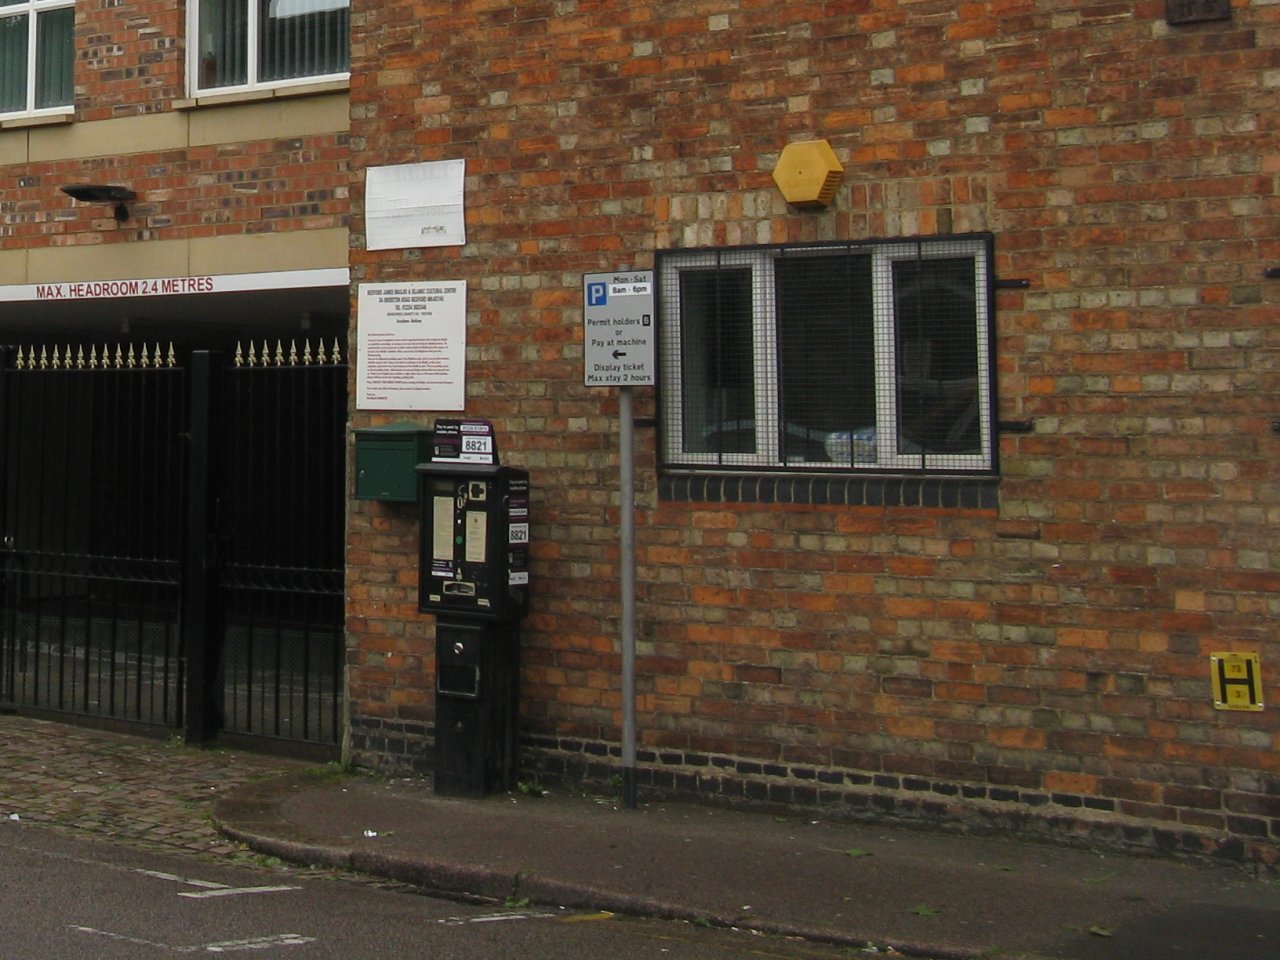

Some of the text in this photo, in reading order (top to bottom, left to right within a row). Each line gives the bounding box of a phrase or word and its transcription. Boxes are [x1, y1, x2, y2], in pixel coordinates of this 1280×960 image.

[613, 276, 628, 284] Mon
[634, 275, 647, 283] Sat
[36, 277, 214, 299] MAX. HEADROOM 2.4 METRES
[612, 286, 626, 294] 8am
[632, 285, 648, 293] 6pm
[591, 284, 604, 304] P
[613, 318, 640, 326] holders
[591, 339, 604, 347] Pay
[616, 338, 646, 346] machine
[593, 363, 644, 372] Display ticket
[606, 374, 620, 383] stay
[465, 440, 487, 451] 8821
[510, 529, 527, 540] 8821
[1217, 658, 1257, 705] H
